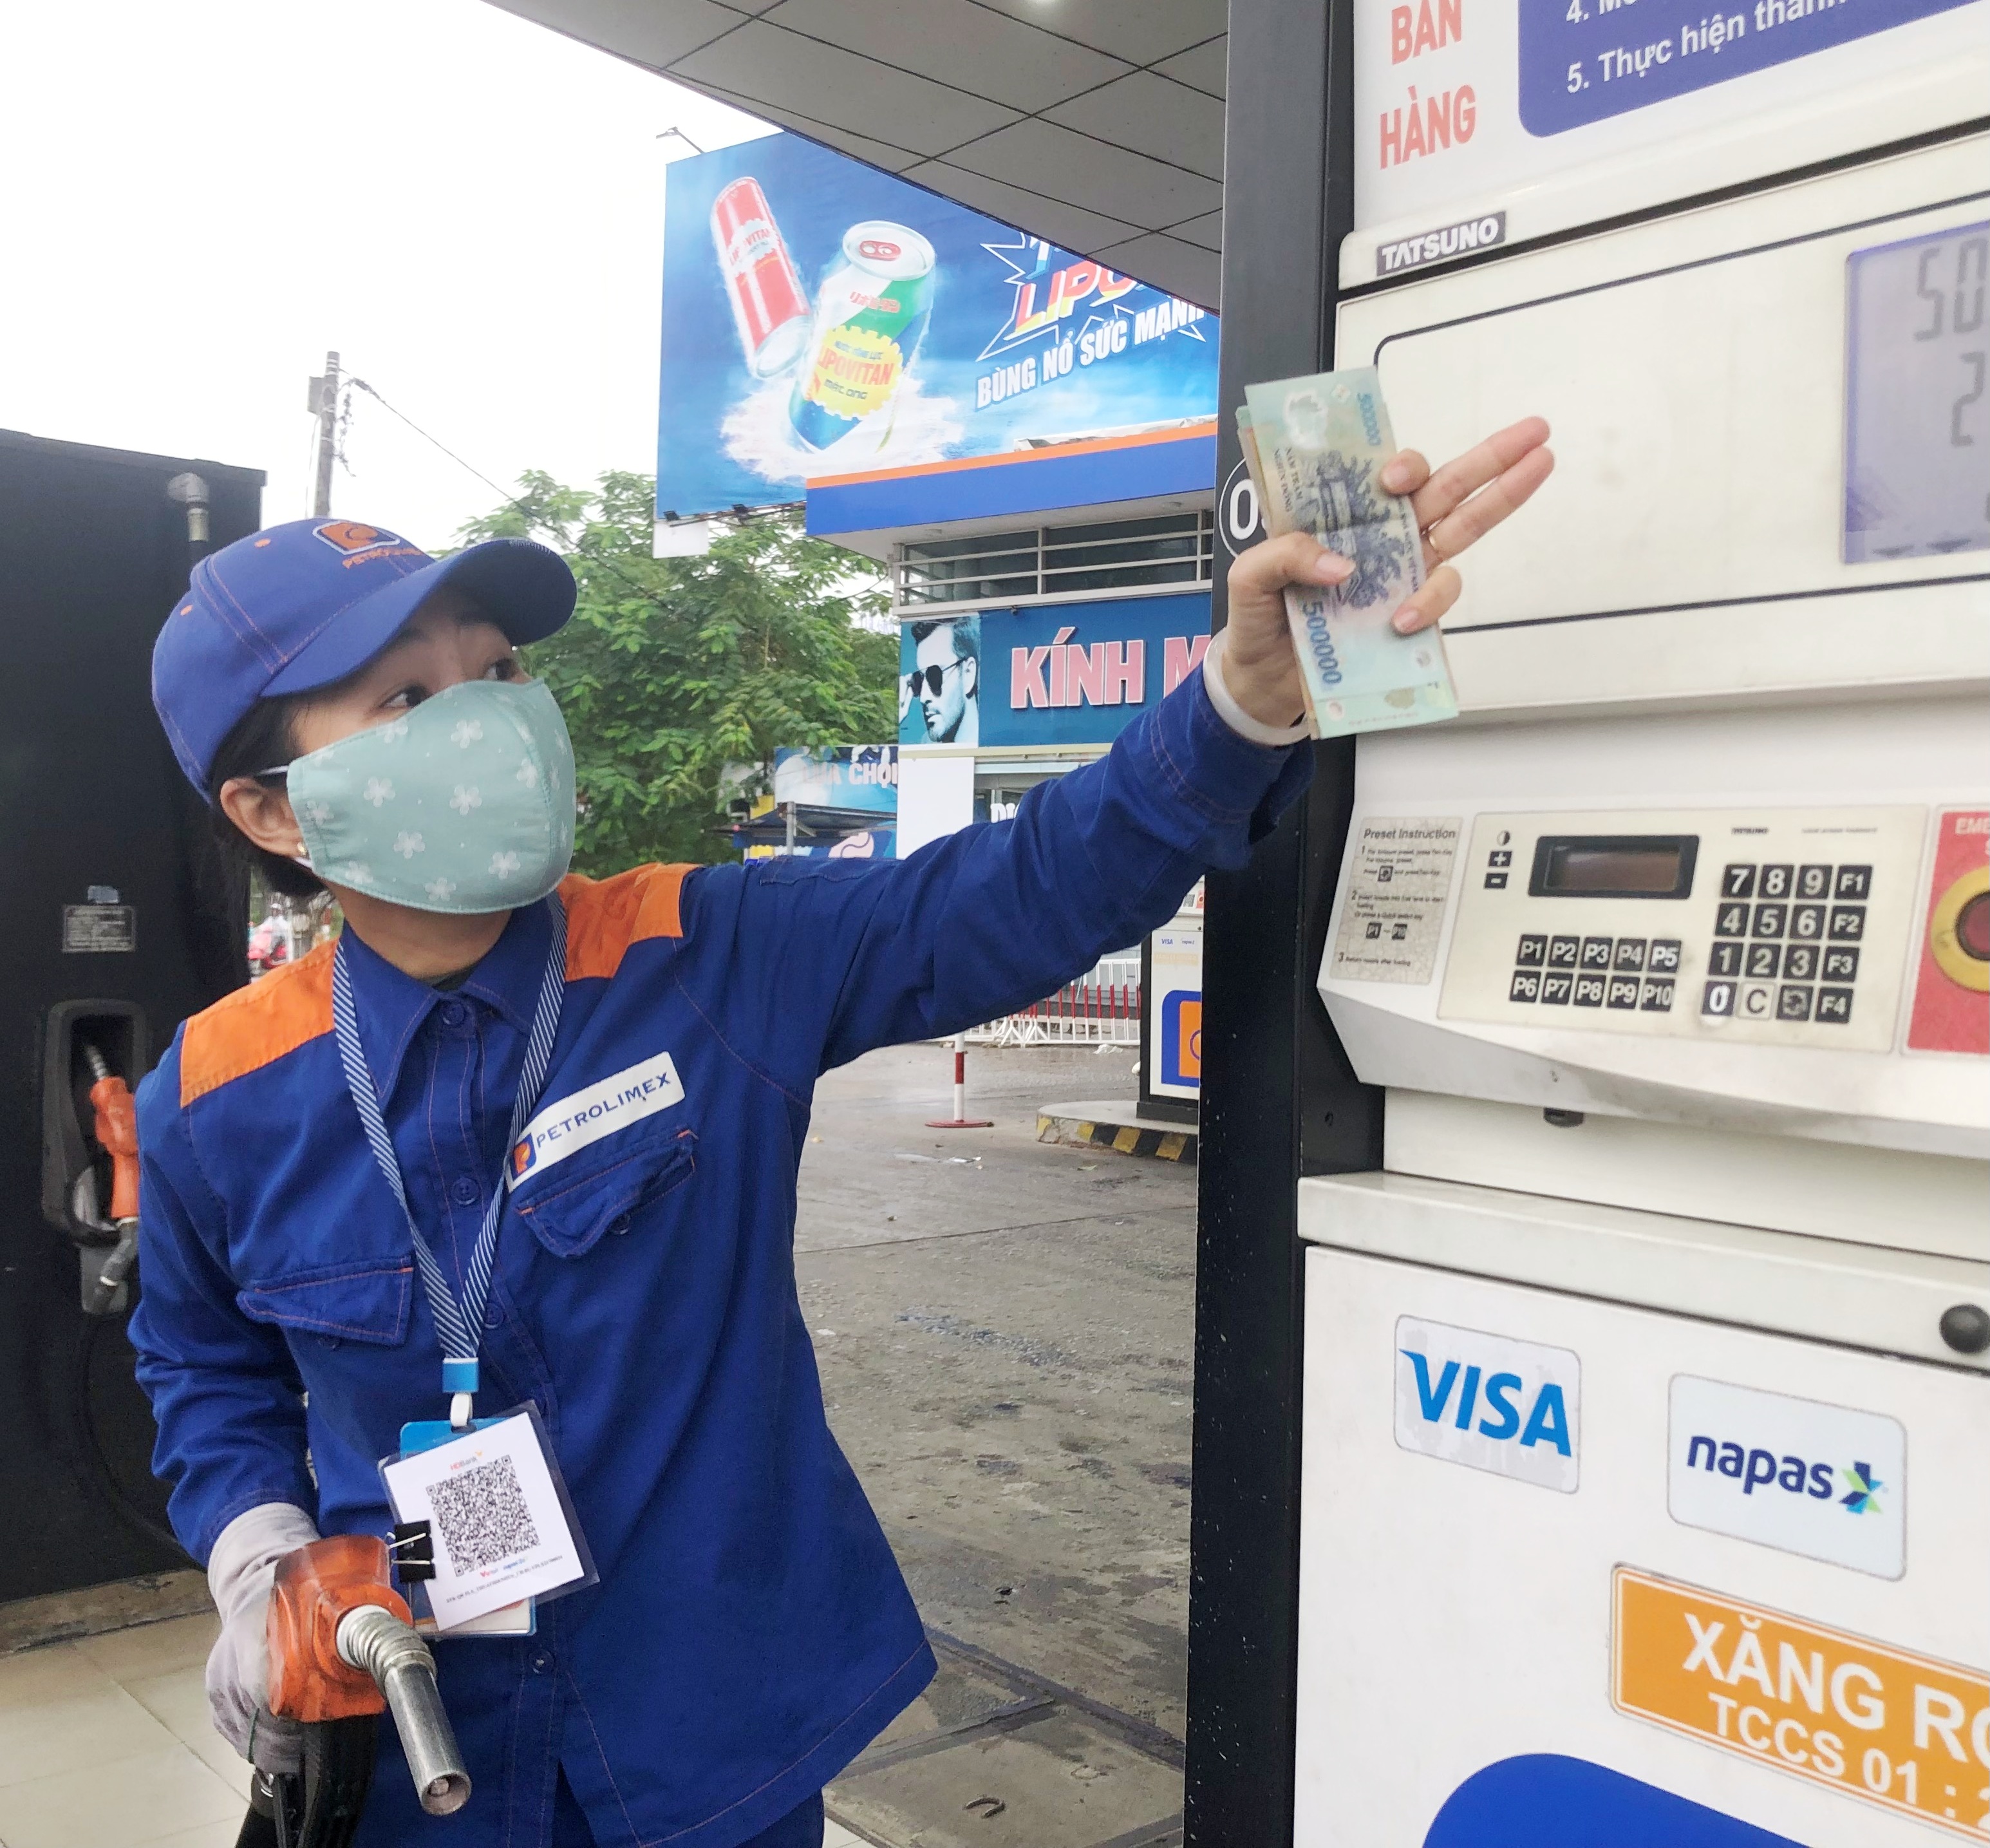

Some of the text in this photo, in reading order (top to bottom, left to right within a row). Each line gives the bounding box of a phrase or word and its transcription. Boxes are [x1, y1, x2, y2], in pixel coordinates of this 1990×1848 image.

[1567, 62, 1590, 93] 5.
[1598, 39, 1672, 82] Thực
[1681, 14, 1745, 58] hiện
[1380, 85, 1476, 170] HÀNG
[1381, 217, 1499, 271] TATSUNO
[976, 357, 1037, 409] BÙNG
[1042, 329, 1075, 382] NỔ
[1079, 319, 1128, 366] SỨC
[1010, 627, 1145, 709] KÍNH
[1302, 600, 1342, 684] 500000
[1364, 828, 1456, 840] Preset Instruction
[1731, 869, 1864, 894] 7 8 9 F1
[1519, 940, 1677, 967] P1 P2 P3 P4 P5
[1722, 908, 1859, 936] 4 5 6 F2
[1513, 977, 1673, 1006] P6 P7 P8 P9 P10
[1718, 947, 1854, 977] 1 2 3 F3
[1709, 984, 1847, 1015] 0 C F4
[536, 1071, 671, 1149] PETROLIMEX
[1398, 1348, 1572, 1458] VISA
[1687, 1435, 1834, 1500] napas
[1682, 1612, 1885, 1730] XĂNG
[1707, 1692, 1846, 1777] TCCS
[1862, 1748, 1917, 1804] 01
